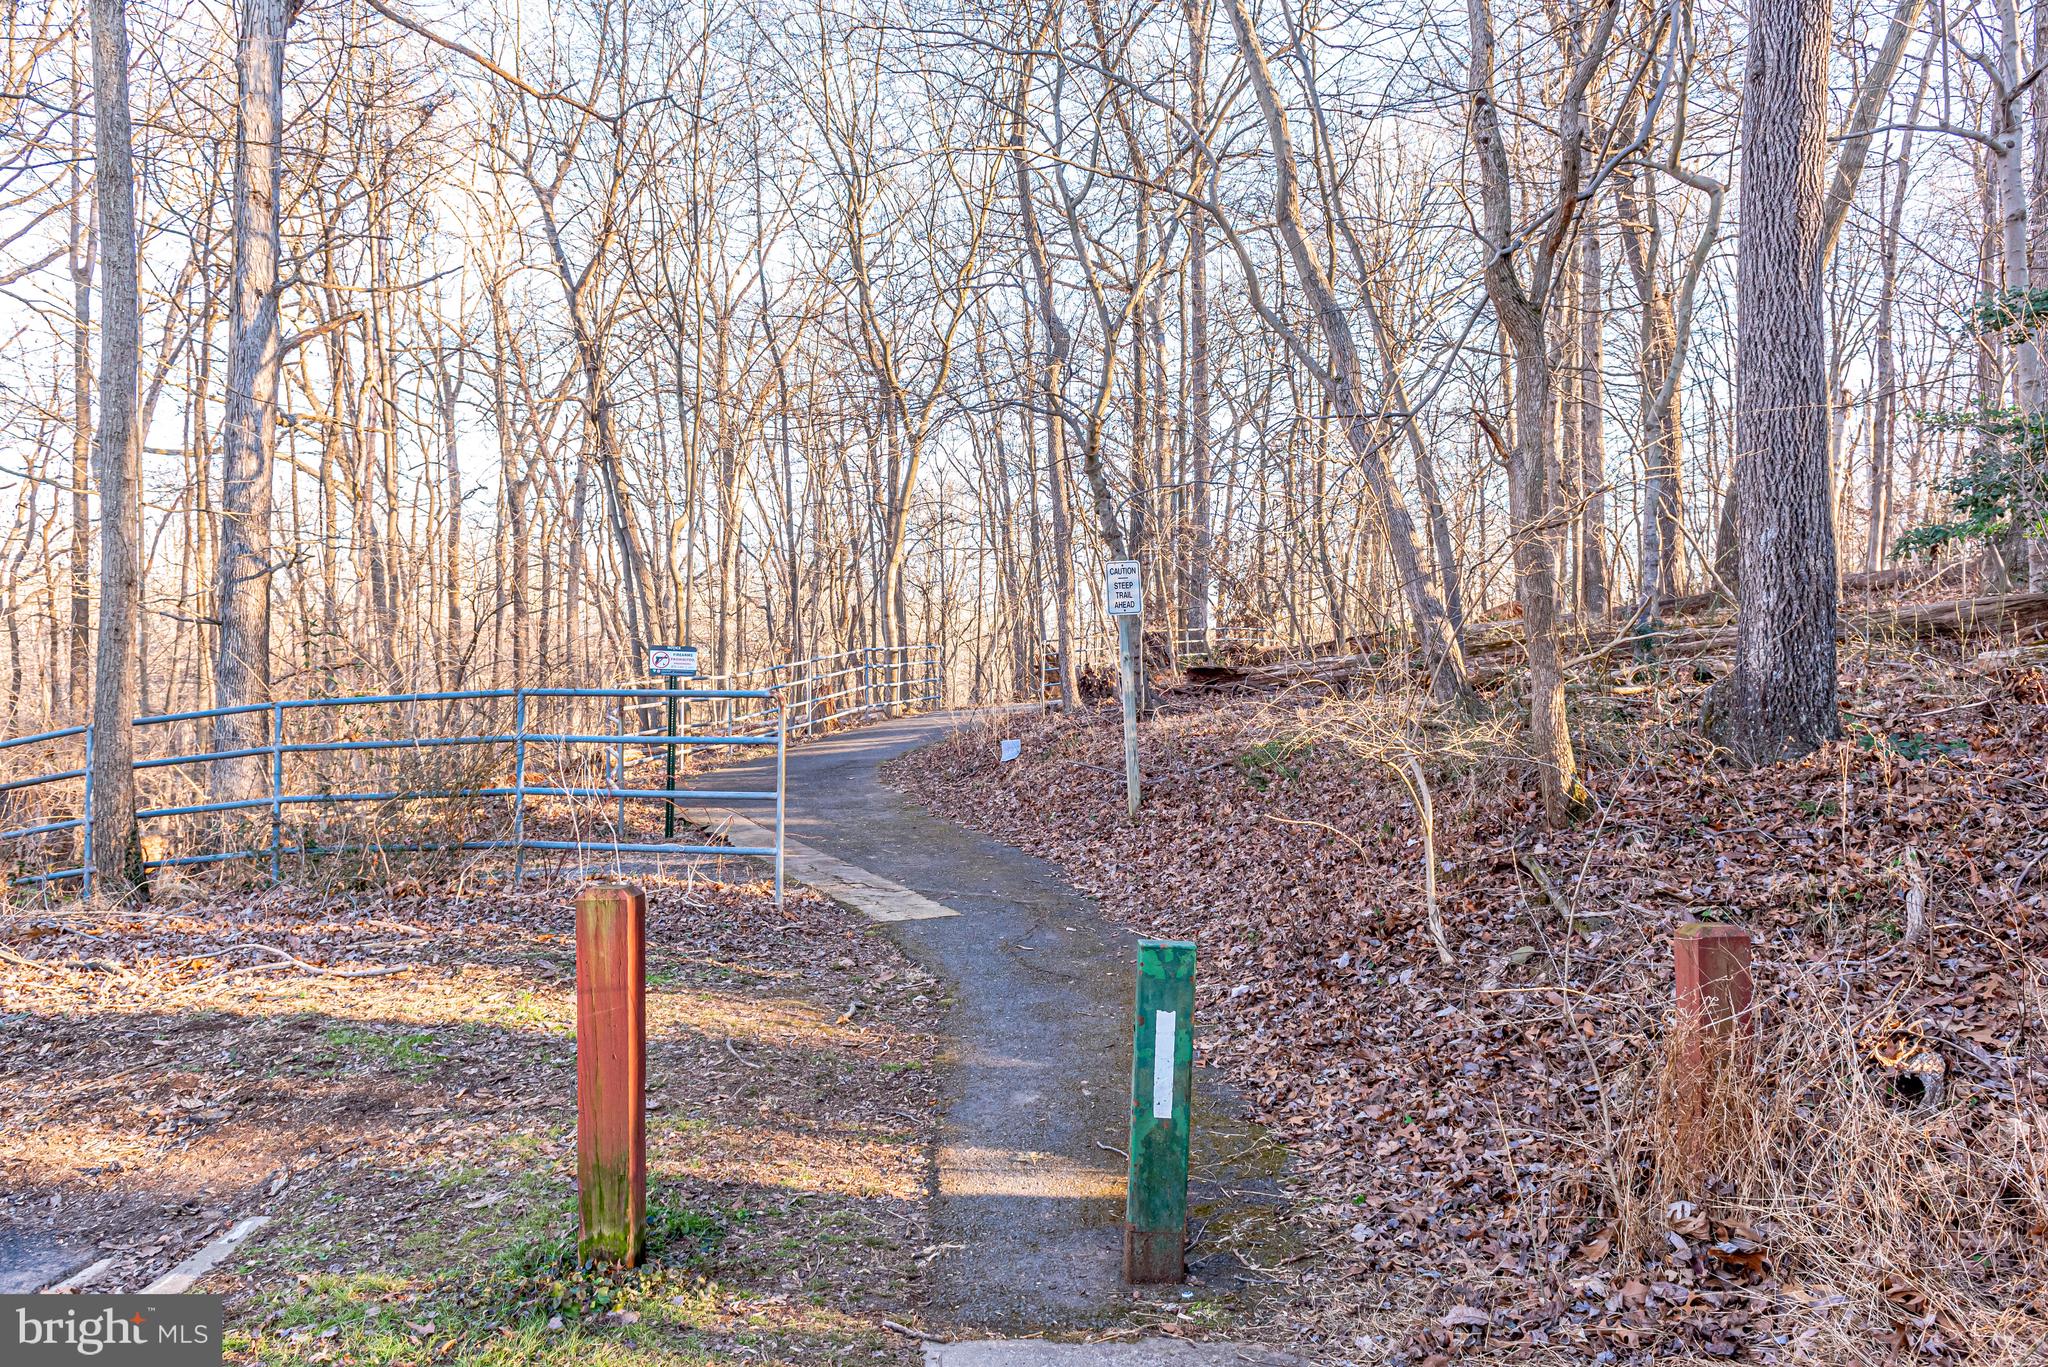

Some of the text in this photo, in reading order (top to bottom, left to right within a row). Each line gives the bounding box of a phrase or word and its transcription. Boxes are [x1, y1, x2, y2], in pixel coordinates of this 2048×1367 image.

[1110, 566, 1136, 576] CAUTION
[1113, 581, 1134, 590] STEEP
[1115, 591, 1134, 599] TRAIL
[1114, 600, 1136, 609] AHEAD
